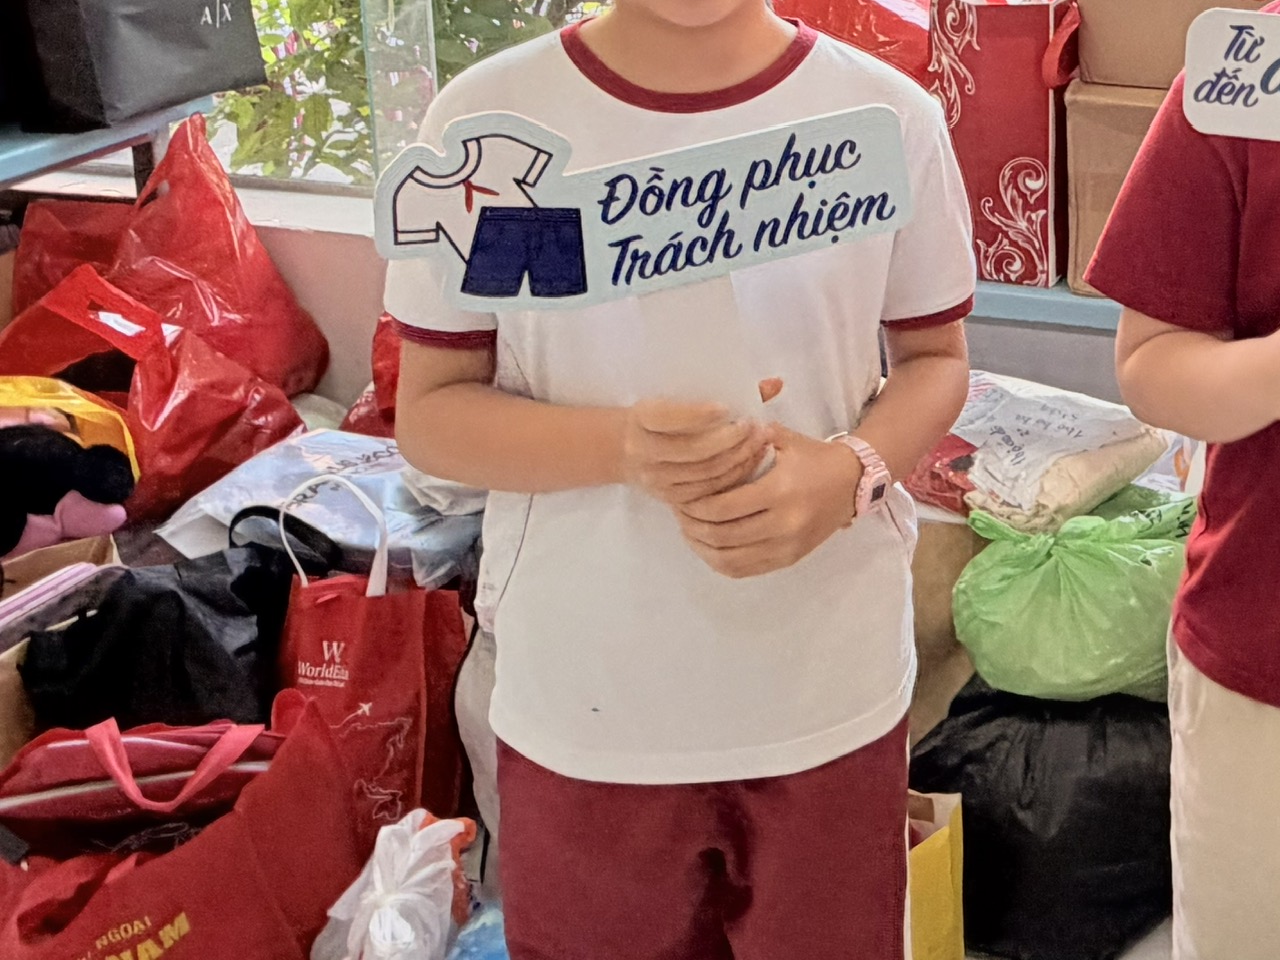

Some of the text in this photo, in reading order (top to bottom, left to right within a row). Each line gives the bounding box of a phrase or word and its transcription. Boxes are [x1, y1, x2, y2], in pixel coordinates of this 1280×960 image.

[1229, 24, 1265, 64] Từ
[1193, 67, 1259, 108] đến
[597, 133, 864, 229] Đồng phục
[607, 191, 897, 287] Trách nhiệm
[322, 640, 346, 664] W
